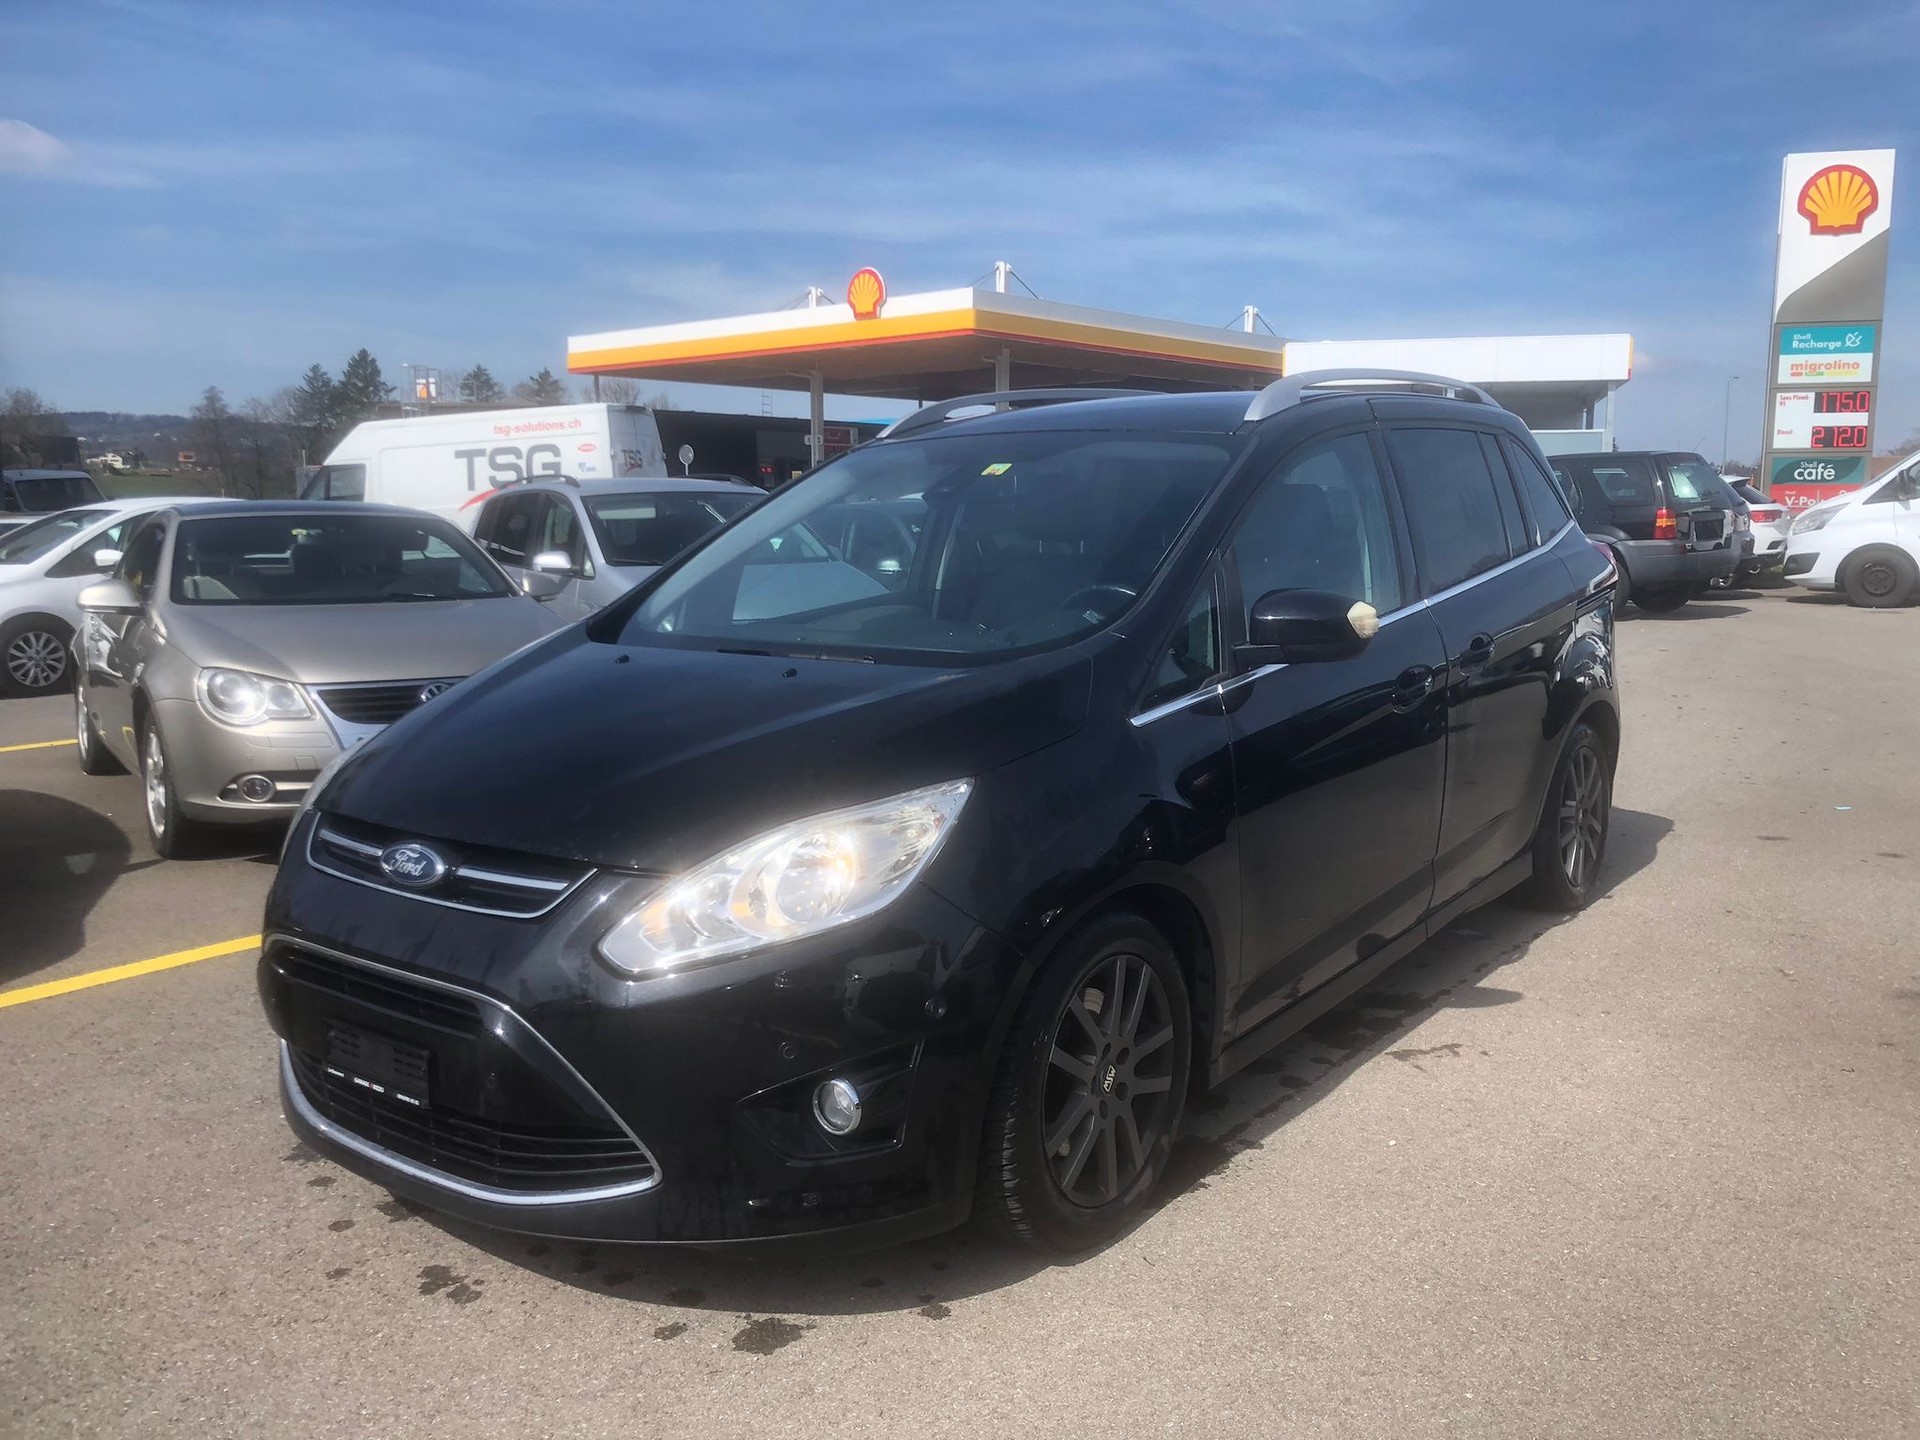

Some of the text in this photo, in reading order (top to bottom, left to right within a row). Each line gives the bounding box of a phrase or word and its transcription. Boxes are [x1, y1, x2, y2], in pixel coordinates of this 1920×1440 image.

[1792, 340, 1842, 350] Recharge
[1790, 360, 1860, 374] migrolino
[493, 419, 582, 436] tsg-solutions.ch
[454, 444, 562, 491] TSG
[1794, 463, 1836, 480] café
[390, 849, 427, 877] Ford
